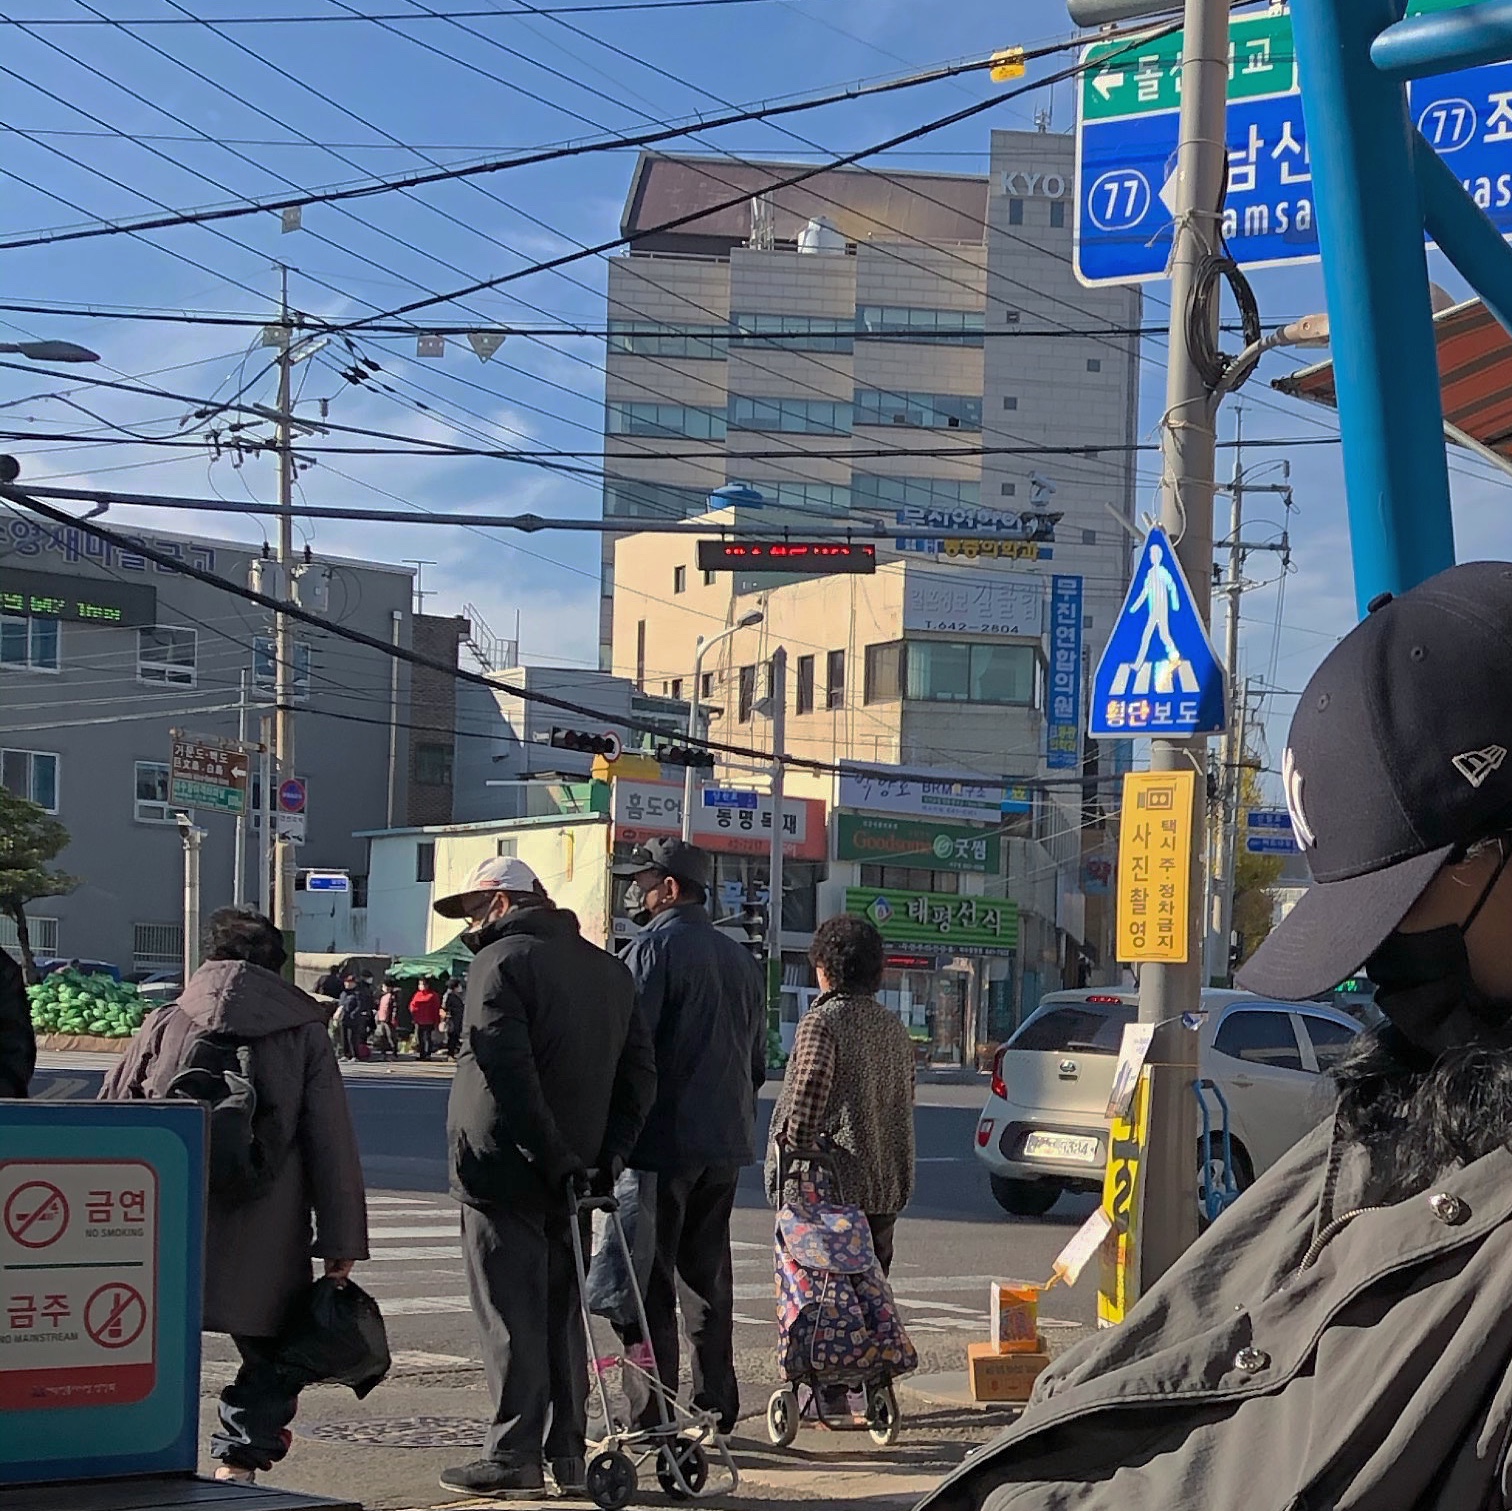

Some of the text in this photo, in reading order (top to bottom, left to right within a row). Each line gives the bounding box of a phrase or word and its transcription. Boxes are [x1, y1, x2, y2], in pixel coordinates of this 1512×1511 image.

[1432, 109, 1465, 144] 77
[1001, 170, 1074, 198] KYO
[1104, 180, 1139, 219] 77
[1222, 199, 1311, 240] amsa
[1106, 700, 1200, 728] 횡단보도
[1160, 820, 1177, 851] 택시
[1129, 822, 1151, 949] 사진촬영
[907, 897, 1001, 938] 태평선식
[85, 1189, 145, 1224] 금연
[85, 1228, 144, 1238] NO SMOKING
[7, 1294, 71, 1329] 금주
[14, 1332, 79, 1343] MAINSTREAM
